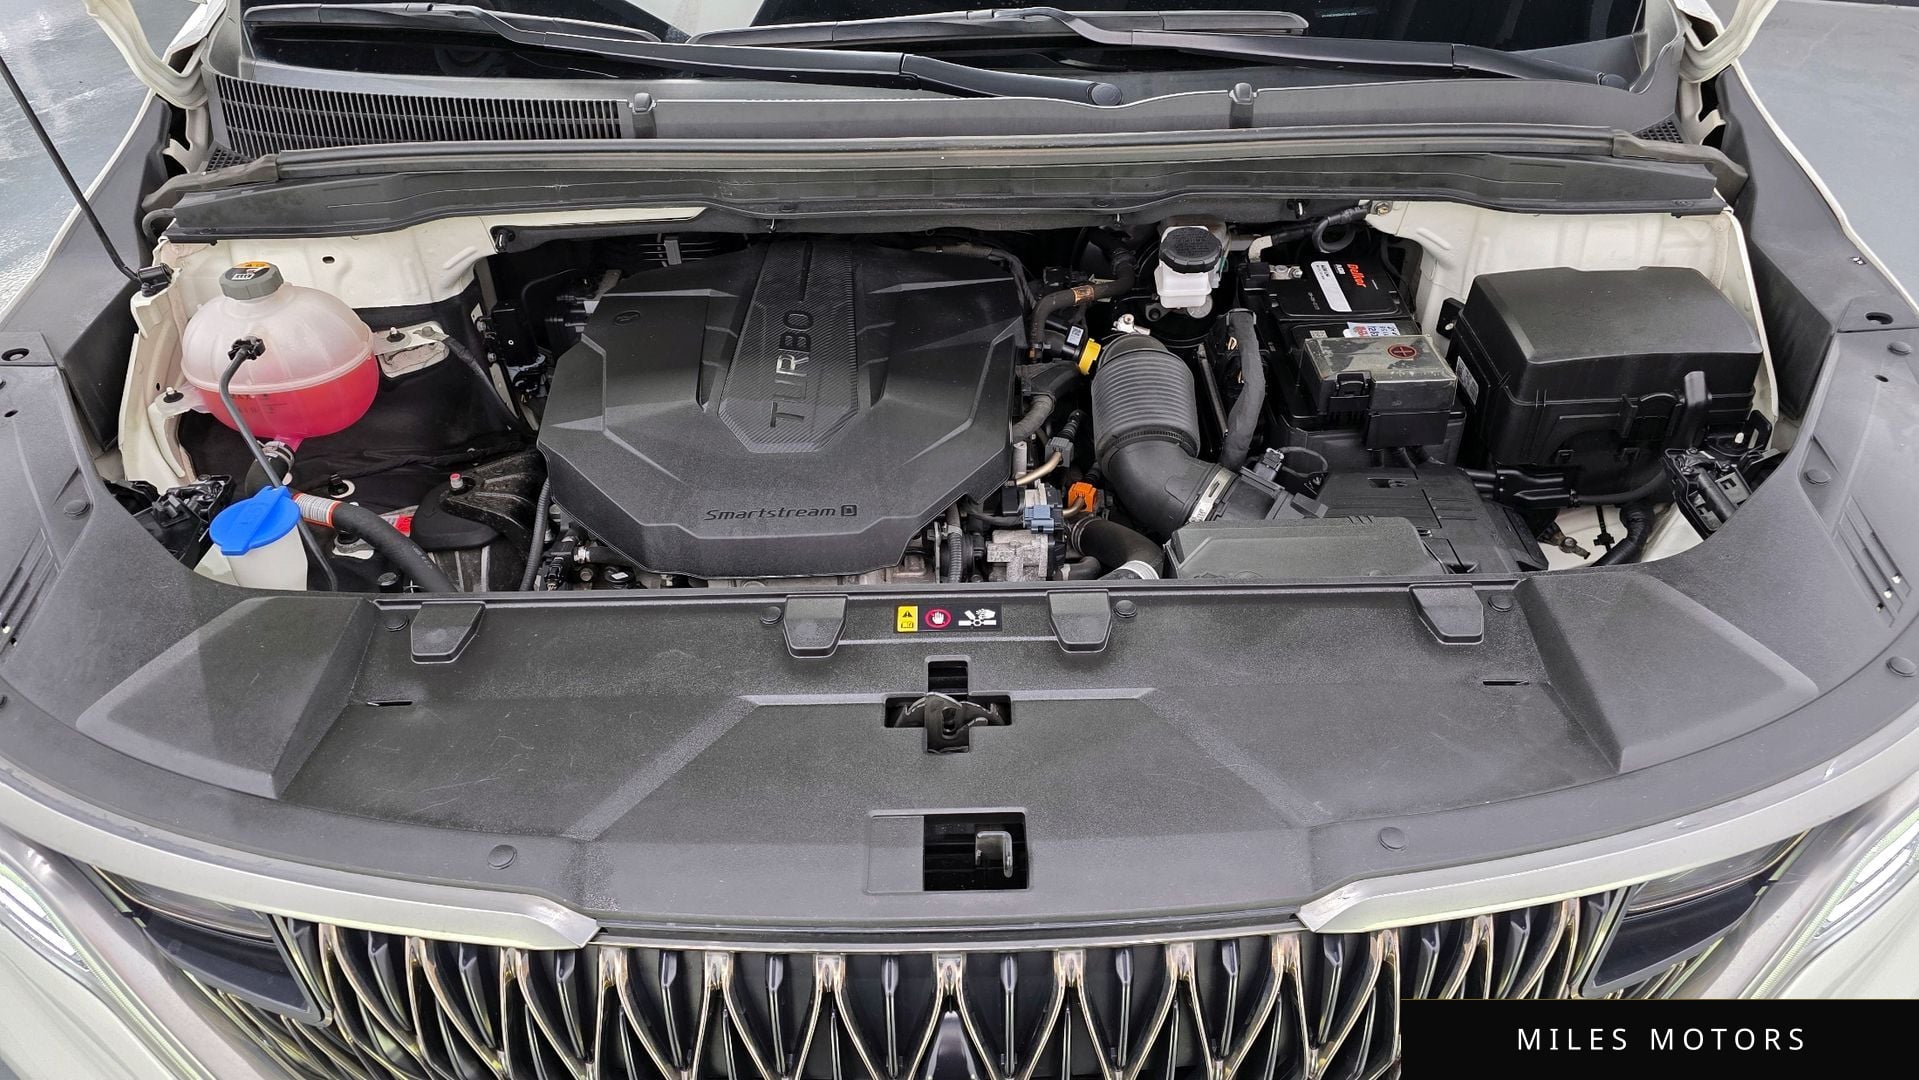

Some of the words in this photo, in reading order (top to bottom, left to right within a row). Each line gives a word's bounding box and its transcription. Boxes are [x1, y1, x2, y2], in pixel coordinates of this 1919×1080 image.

[1346, 263, 1367, 288] Delkor
[770, 310, 814, 428] TURBO
[704, 507, 836, 521] Smartstream
